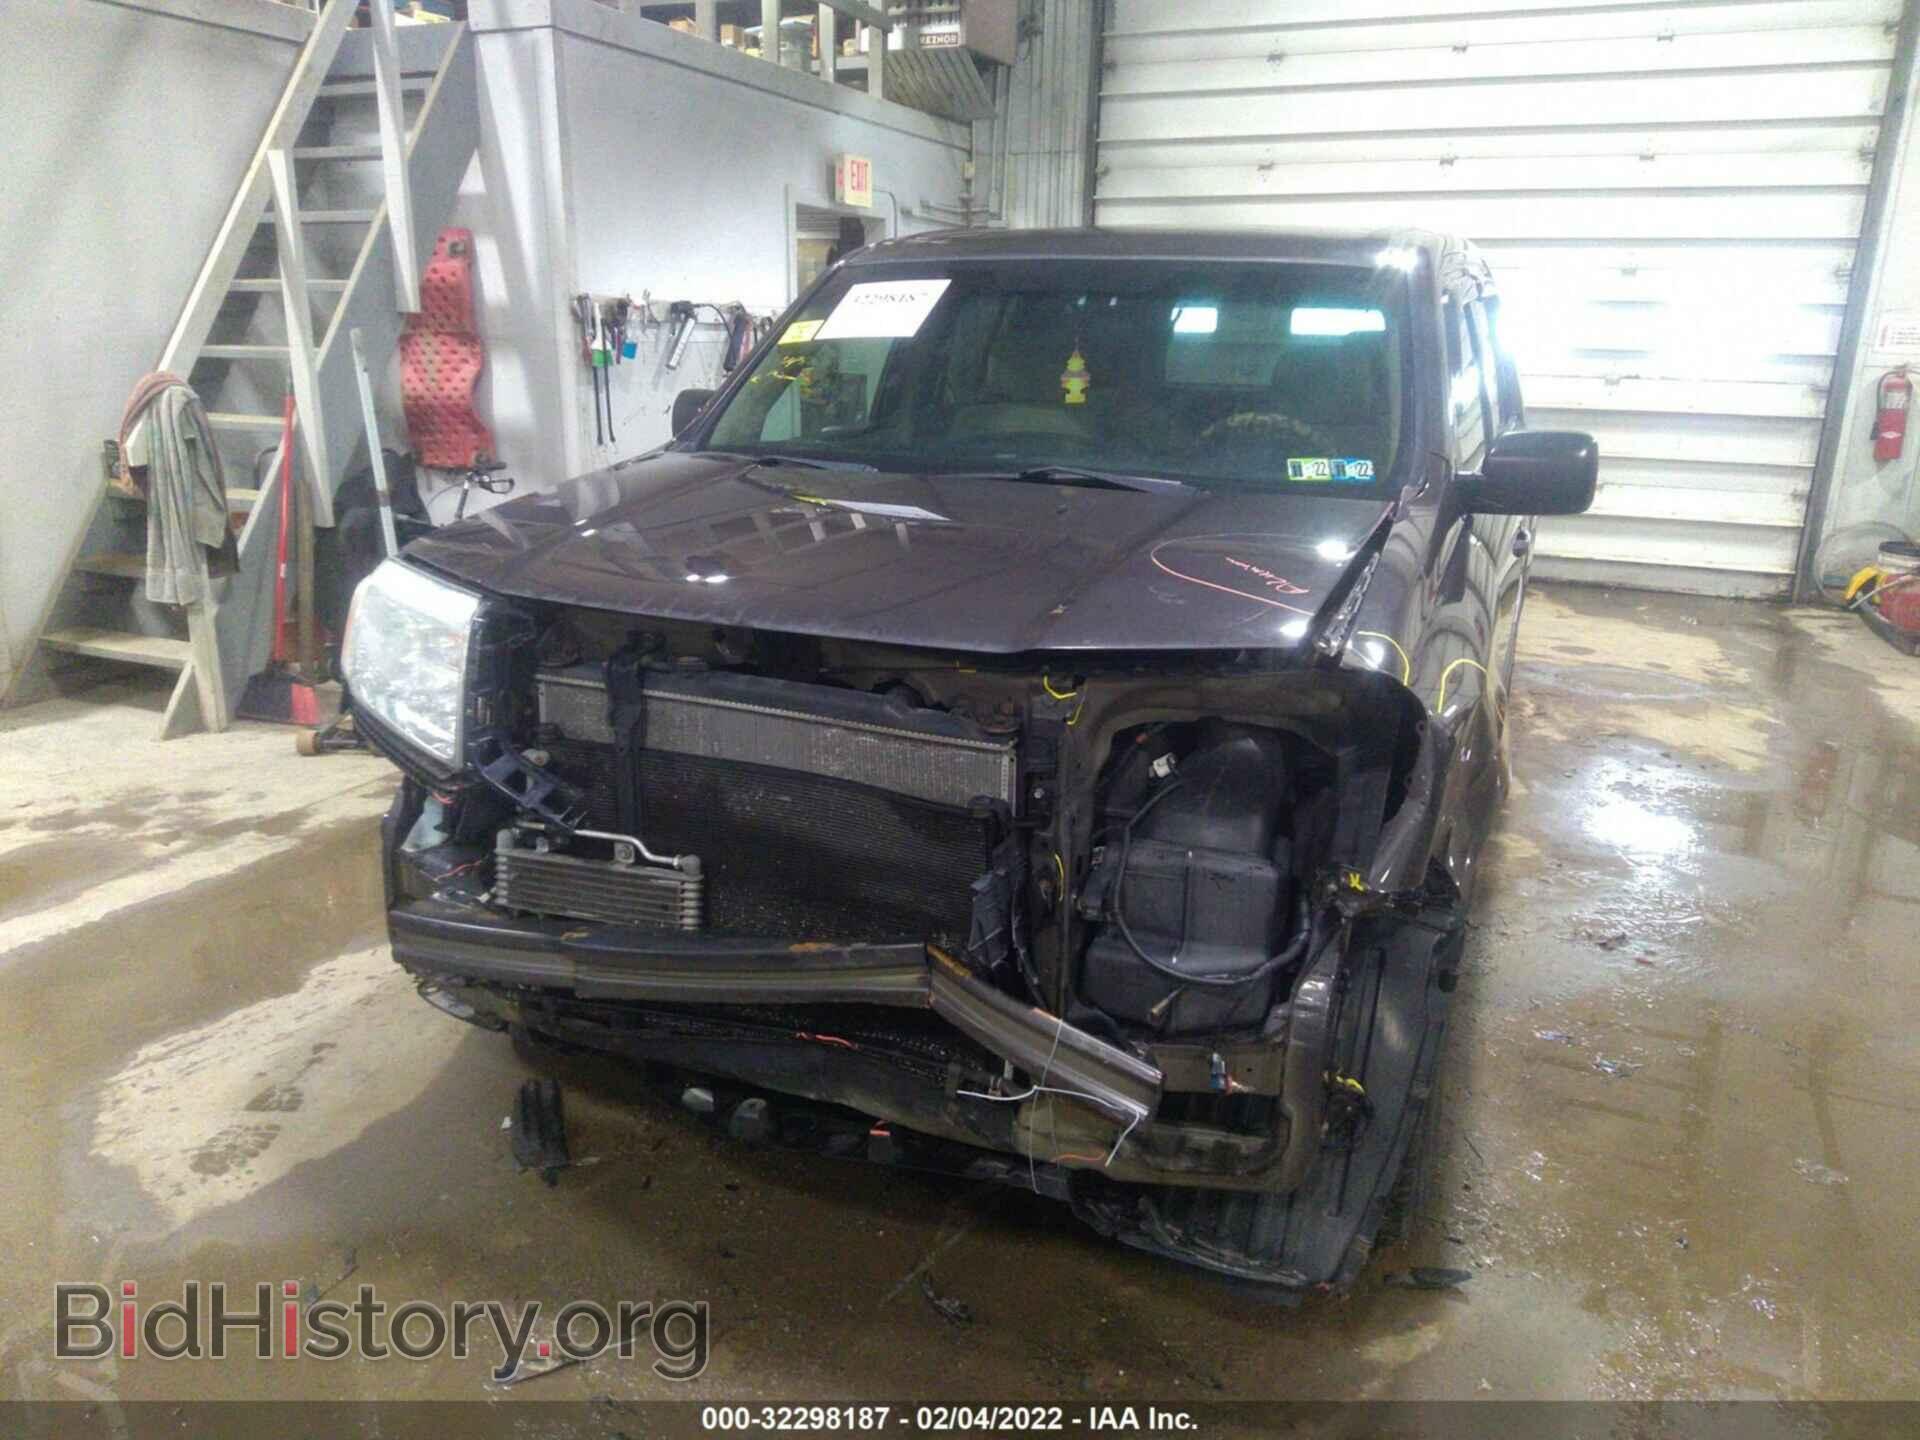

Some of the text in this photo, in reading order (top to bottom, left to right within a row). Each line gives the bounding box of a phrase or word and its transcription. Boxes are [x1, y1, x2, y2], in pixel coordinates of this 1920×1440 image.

[850, 160, 868, 192] EXIT
[1313, 461, 1328, 476] 22
[1356, 462, 1370, 476] 22
